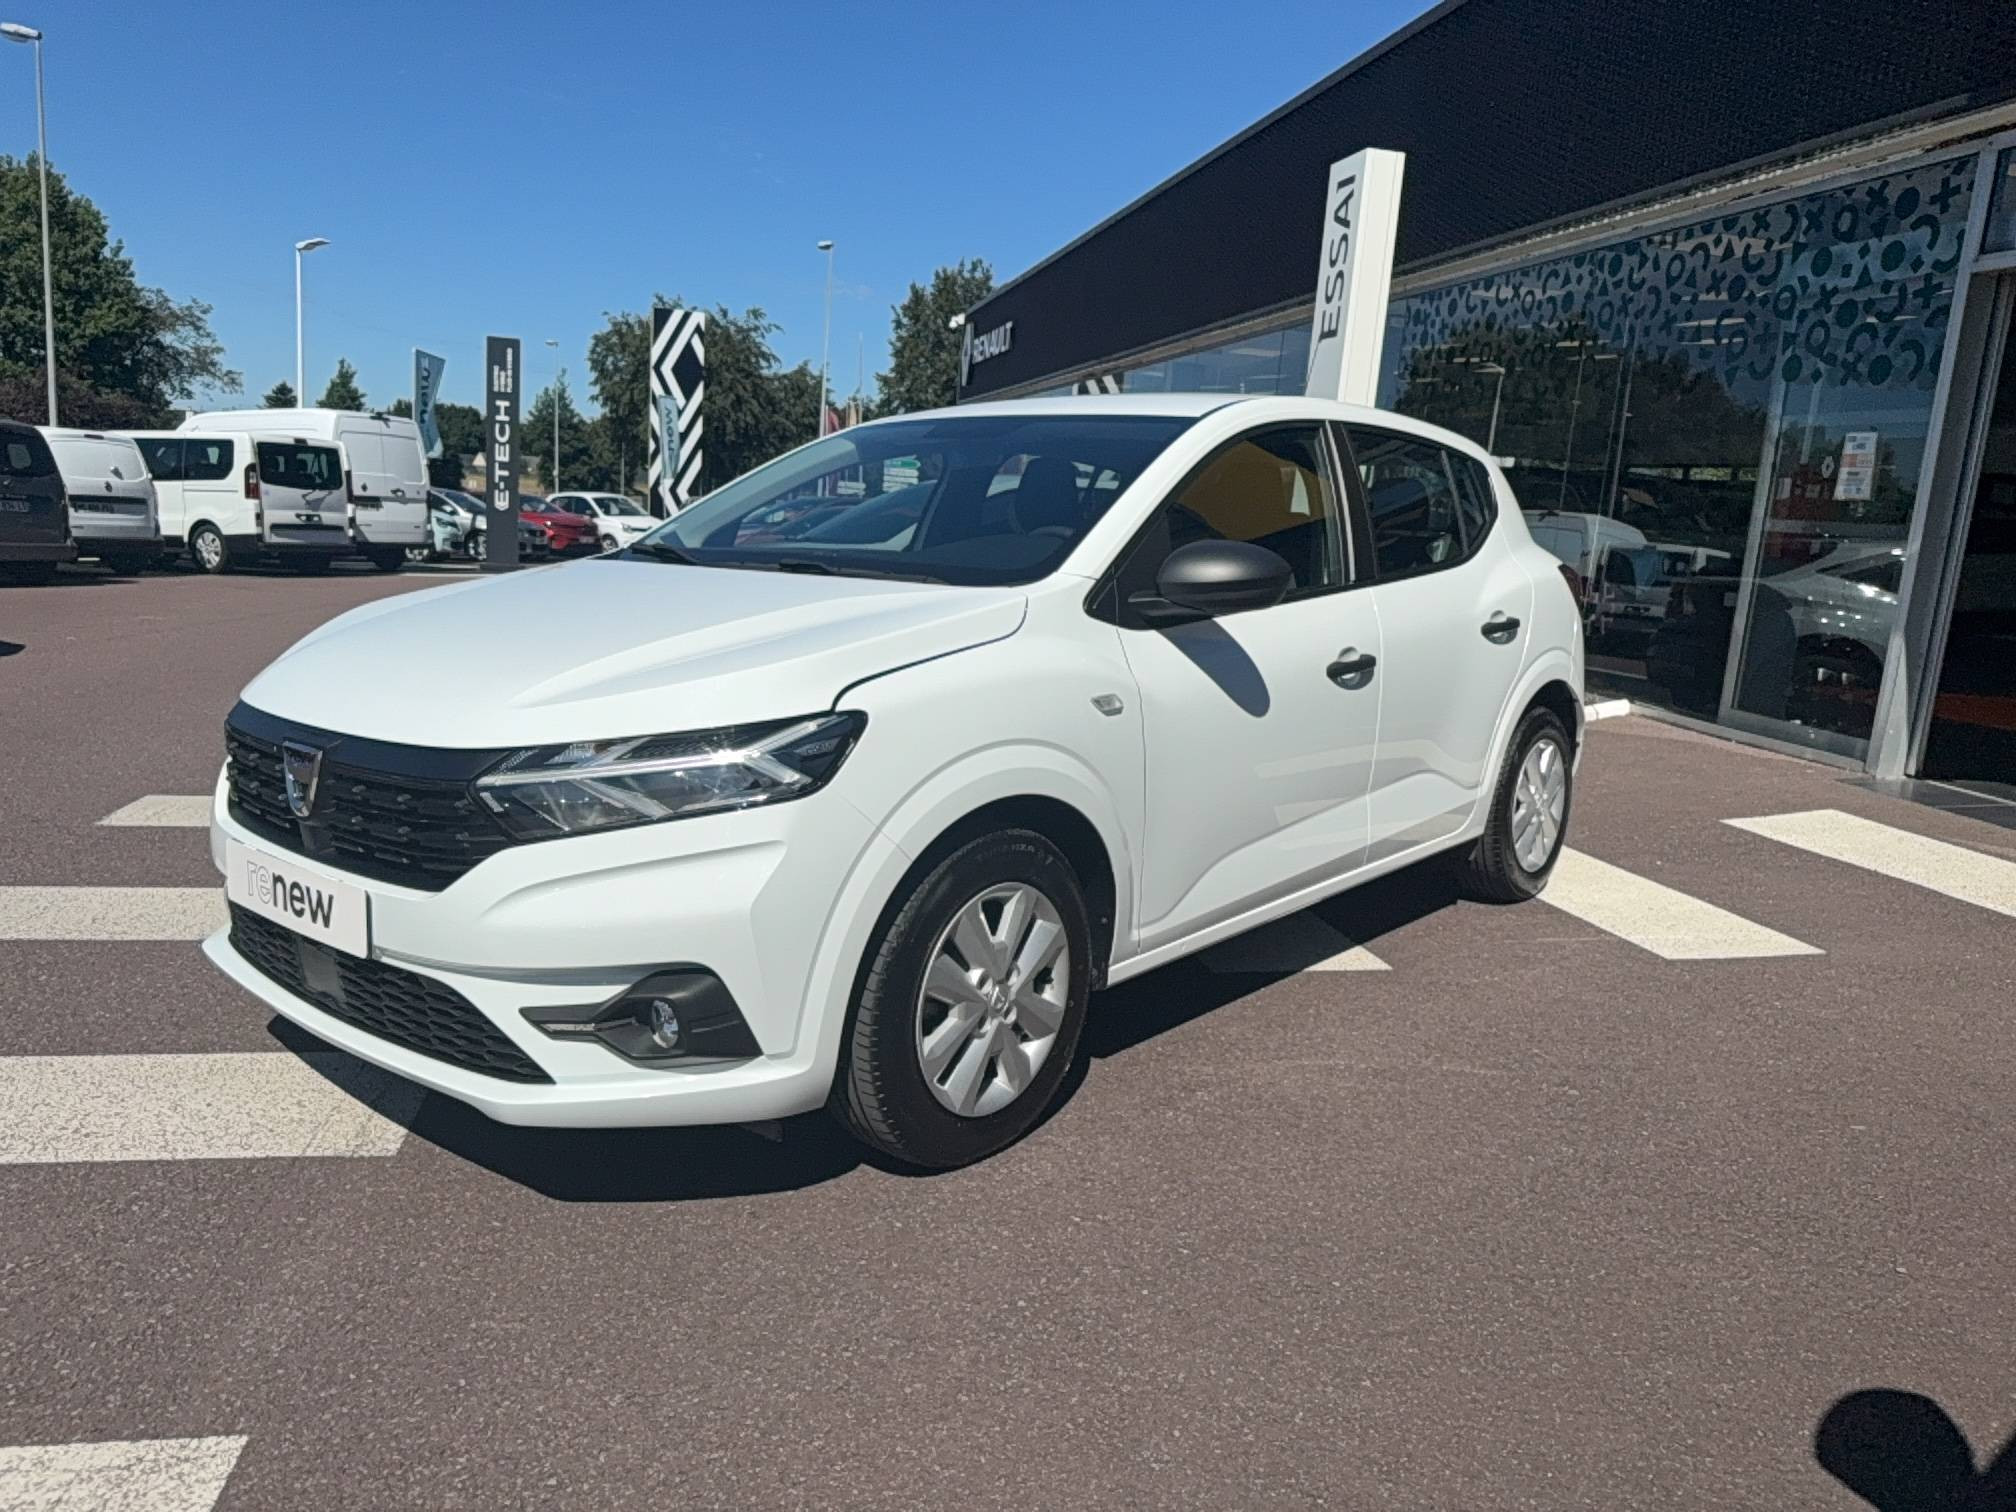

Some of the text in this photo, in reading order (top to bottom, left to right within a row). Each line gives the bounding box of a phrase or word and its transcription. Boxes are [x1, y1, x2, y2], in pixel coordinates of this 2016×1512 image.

[1318, 174, 1357, 343] ESSAI
[972, 321, 1013, 365] RENAULT
[494, 400, 511, 512] E-TECH
[246, 860, 335, 929] renew
